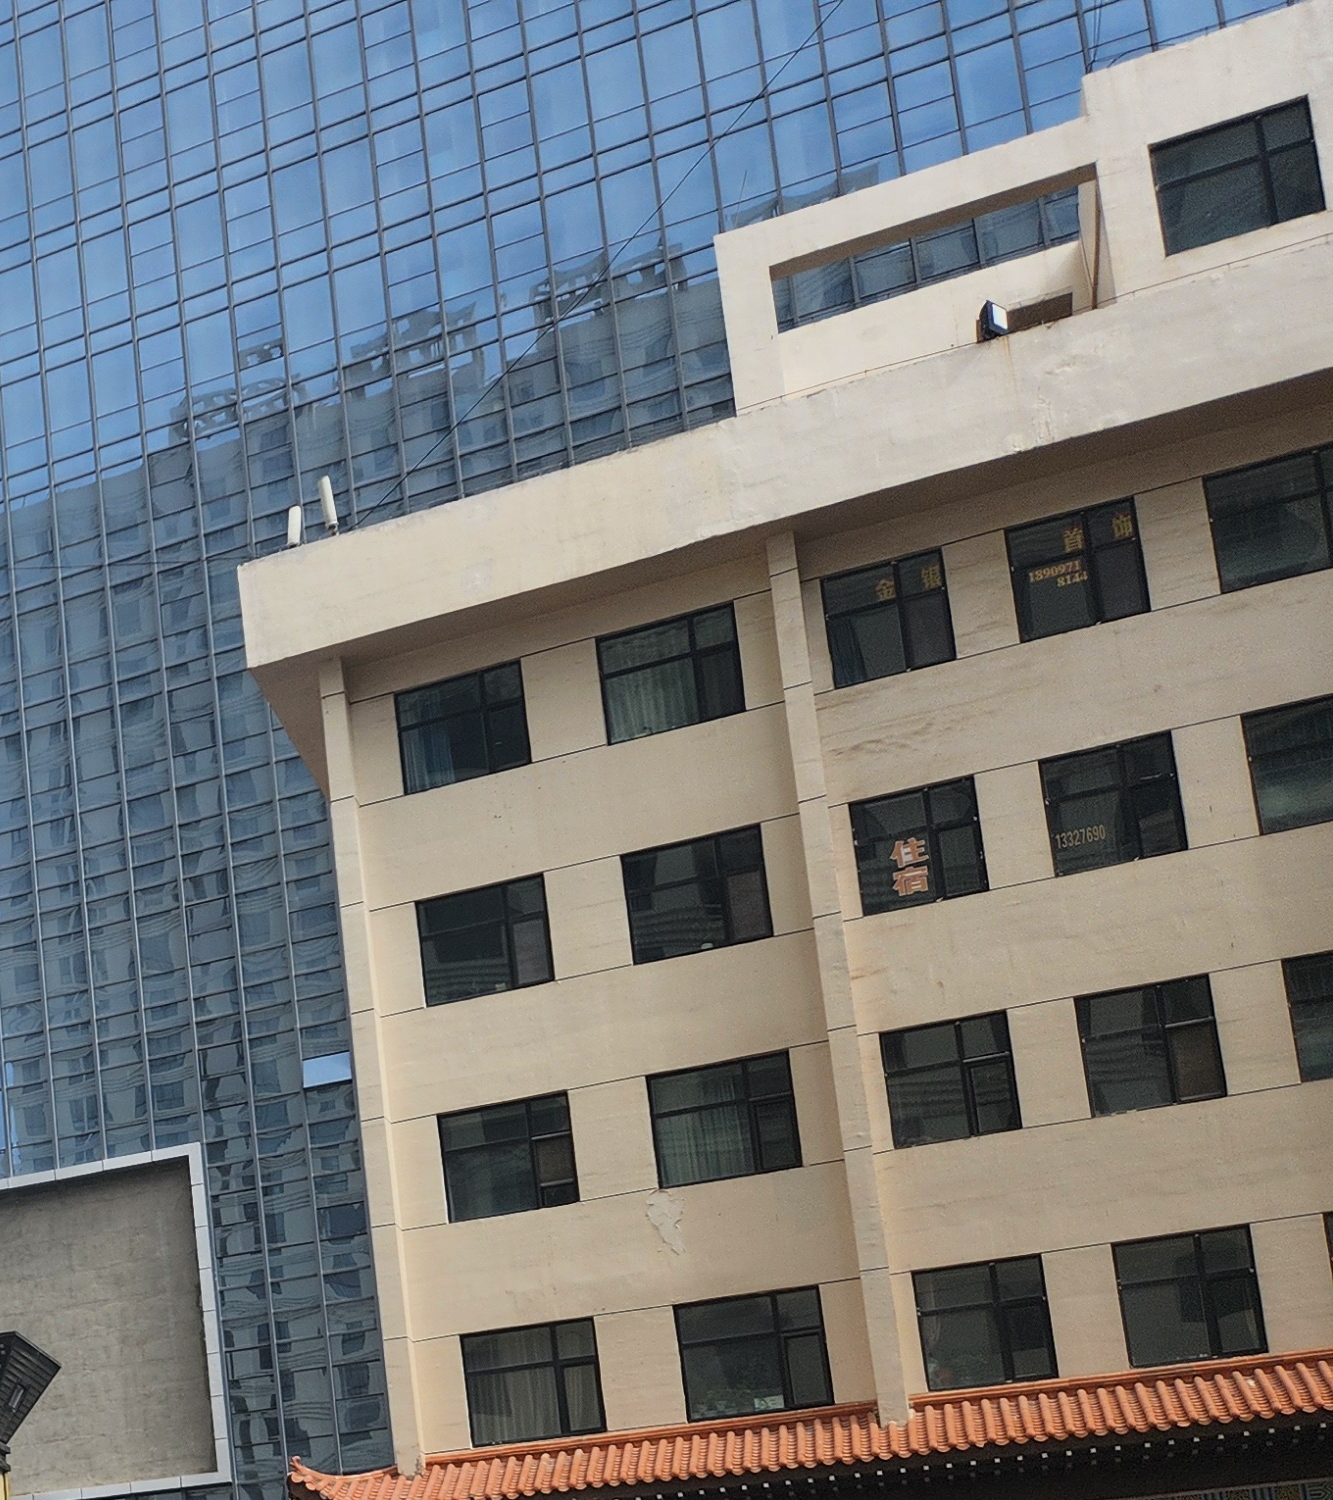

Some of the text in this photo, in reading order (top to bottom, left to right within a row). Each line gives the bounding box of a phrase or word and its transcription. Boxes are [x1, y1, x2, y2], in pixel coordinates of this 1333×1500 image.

[1028, 560, 1081, 584] 1890971
[1054, 824, 1106, 850] 13327690
[889, 837, 930, 897] 住宿
